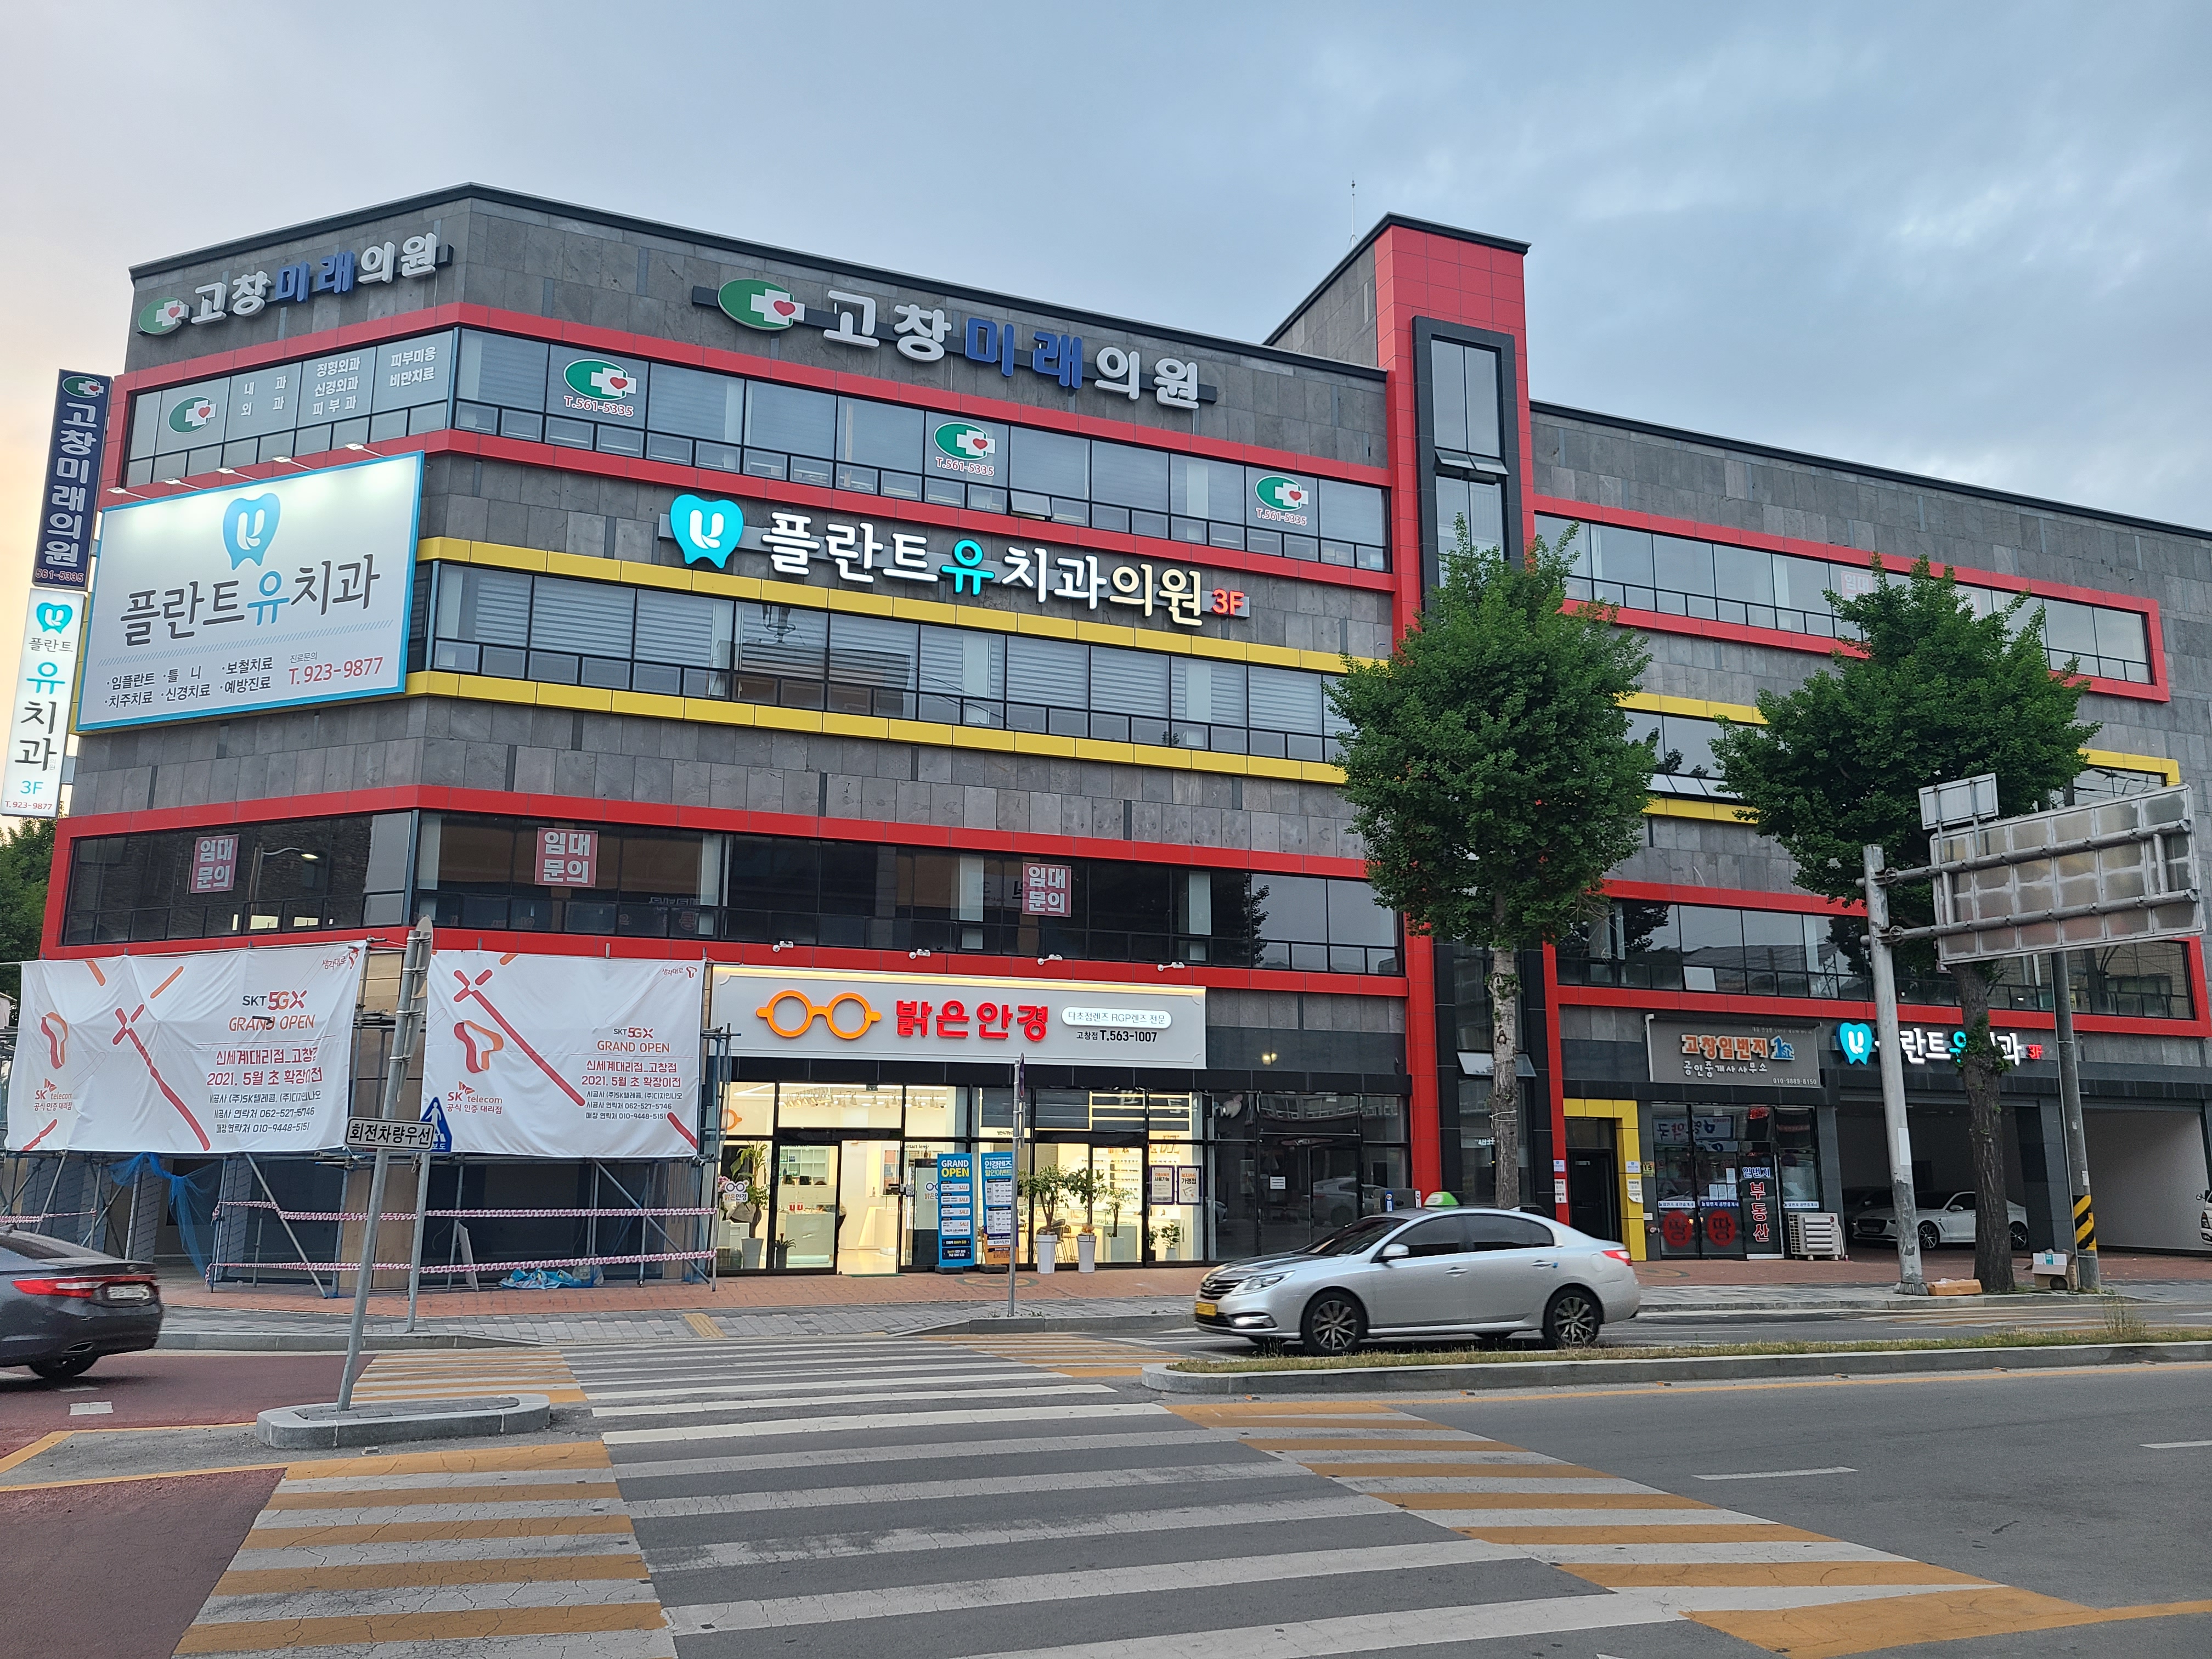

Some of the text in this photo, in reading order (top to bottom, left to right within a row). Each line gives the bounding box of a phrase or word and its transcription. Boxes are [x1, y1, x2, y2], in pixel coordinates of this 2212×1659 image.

[191, 232, 437, 325] 고창미래의원
[823, 290, 1200, 410] 고창미래의원
[317, 357, 360, 377] 정형외과
[390, 366, 435, 387] 비만치료
[314, 376, 358, 397] 신경외과
[563, 395, 635, 417] T.561-5335
[936, 456, 995, 477] T.561-5335
[44, 402, 97, 567] 고창미래의원
[1255, 507, 1307, 526] T.561-5335
[36, 568, 84, 583] 561-5335
[1844, 574, 1869, 591] 임대
[120, 553, 381, 646] 플란트유치과
[1212, 588, 1244, 616] 3F
[29, 636, 74, 653] 플란트
[289, 651, 318, 664] 진료문의
[20, 781, 43, 794] 3F
[4, 800, 53, 810] T.923-9877
[200, 839, 233, 862] 임대
[544, 832, 590, 856] 임대
[197, 865, 230, 889] 문의
[544, 859, 589, 883] 문의
[1028, 866, 1065, 889] 임대
[1029, 891, 1065, 913] 문의
[322, 956, 346, 970] 생각대로
[662, 968, 684, 976] 생각대로
[229, 1014, 315, 1031] GRAND OPEN
[895, 999, 1049, 1042] 밝은안경
[1068, 1012, 1166, 1024] 다초점렌즈 RGP렌즈 전문
[1076, 1030, 1157, 1042] 고창점 T.563-1007
[597, 1040, 670, 1053] GRAND OPEN
[1681, 1035, 1768, 1060] 고창일번지
[2028, 1045, 2042, 1059] 3F
[207, 1067, 322, 1086] 2021. 5월 초 확장이전
[582, 1076, 681, 1087] 2021. 5월 초 확장이전
[35, 1090, 48, 1100] SK
[448, 1092, 503, 1104] SK telecom
[33, 1102, 72, 1111] 공식 인증 대리점
[234, 1109, 257, 1118] 연락처
[259, 1107, 315, 1118] 062-527-5746
[446, 1104, 503, 1114] 공식 인증 대리점
[228, 1124, 250, 1133] 연락처
[252, 1122, 309, 1132] 010-9448-5151
[349, 1123, 432, 1146] 회전차량우선
[941, 1167, 969, 1177] OPEN
[985, 1160, 1012, 1169] 안경렌즈
[1742, 1167, 1770, 1178] 일번지
[1750, 1182, 1769, 1243] 부동산
[1713, 1217, 1731, 1240] 땅
